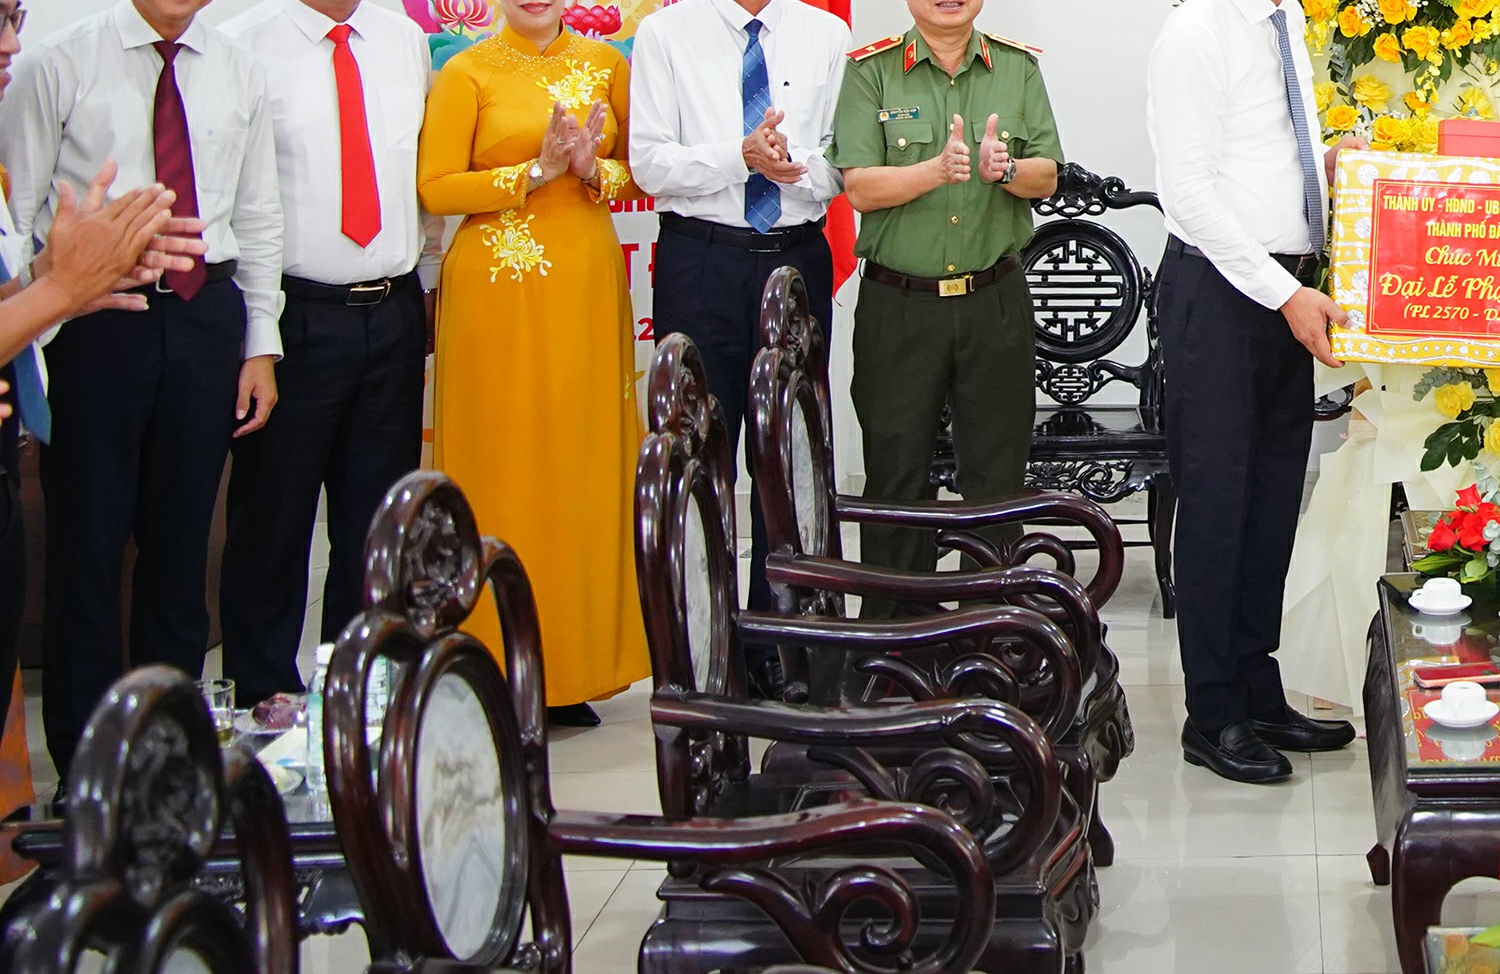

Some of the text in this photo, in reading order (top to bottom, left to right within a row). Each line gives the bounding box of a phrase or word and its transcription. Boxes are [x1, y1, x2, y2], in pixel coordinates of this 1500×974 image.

[1383, 193, 1418, 212] THÀNH
[1445, 199, 1475, 214] HĐND
[1427, 219, 1463, 237] THÀNH
[1465, 217, 1486, 239] PHỐ
[1424, 245, 1473, 266] Chúc
[1379, 274, 1426, 300] Đại
[1427, 275, 1459, 298] Lễ
[1404, 303, 1430, 319] (PL
[1433, 305, 1469, 320] 2570
